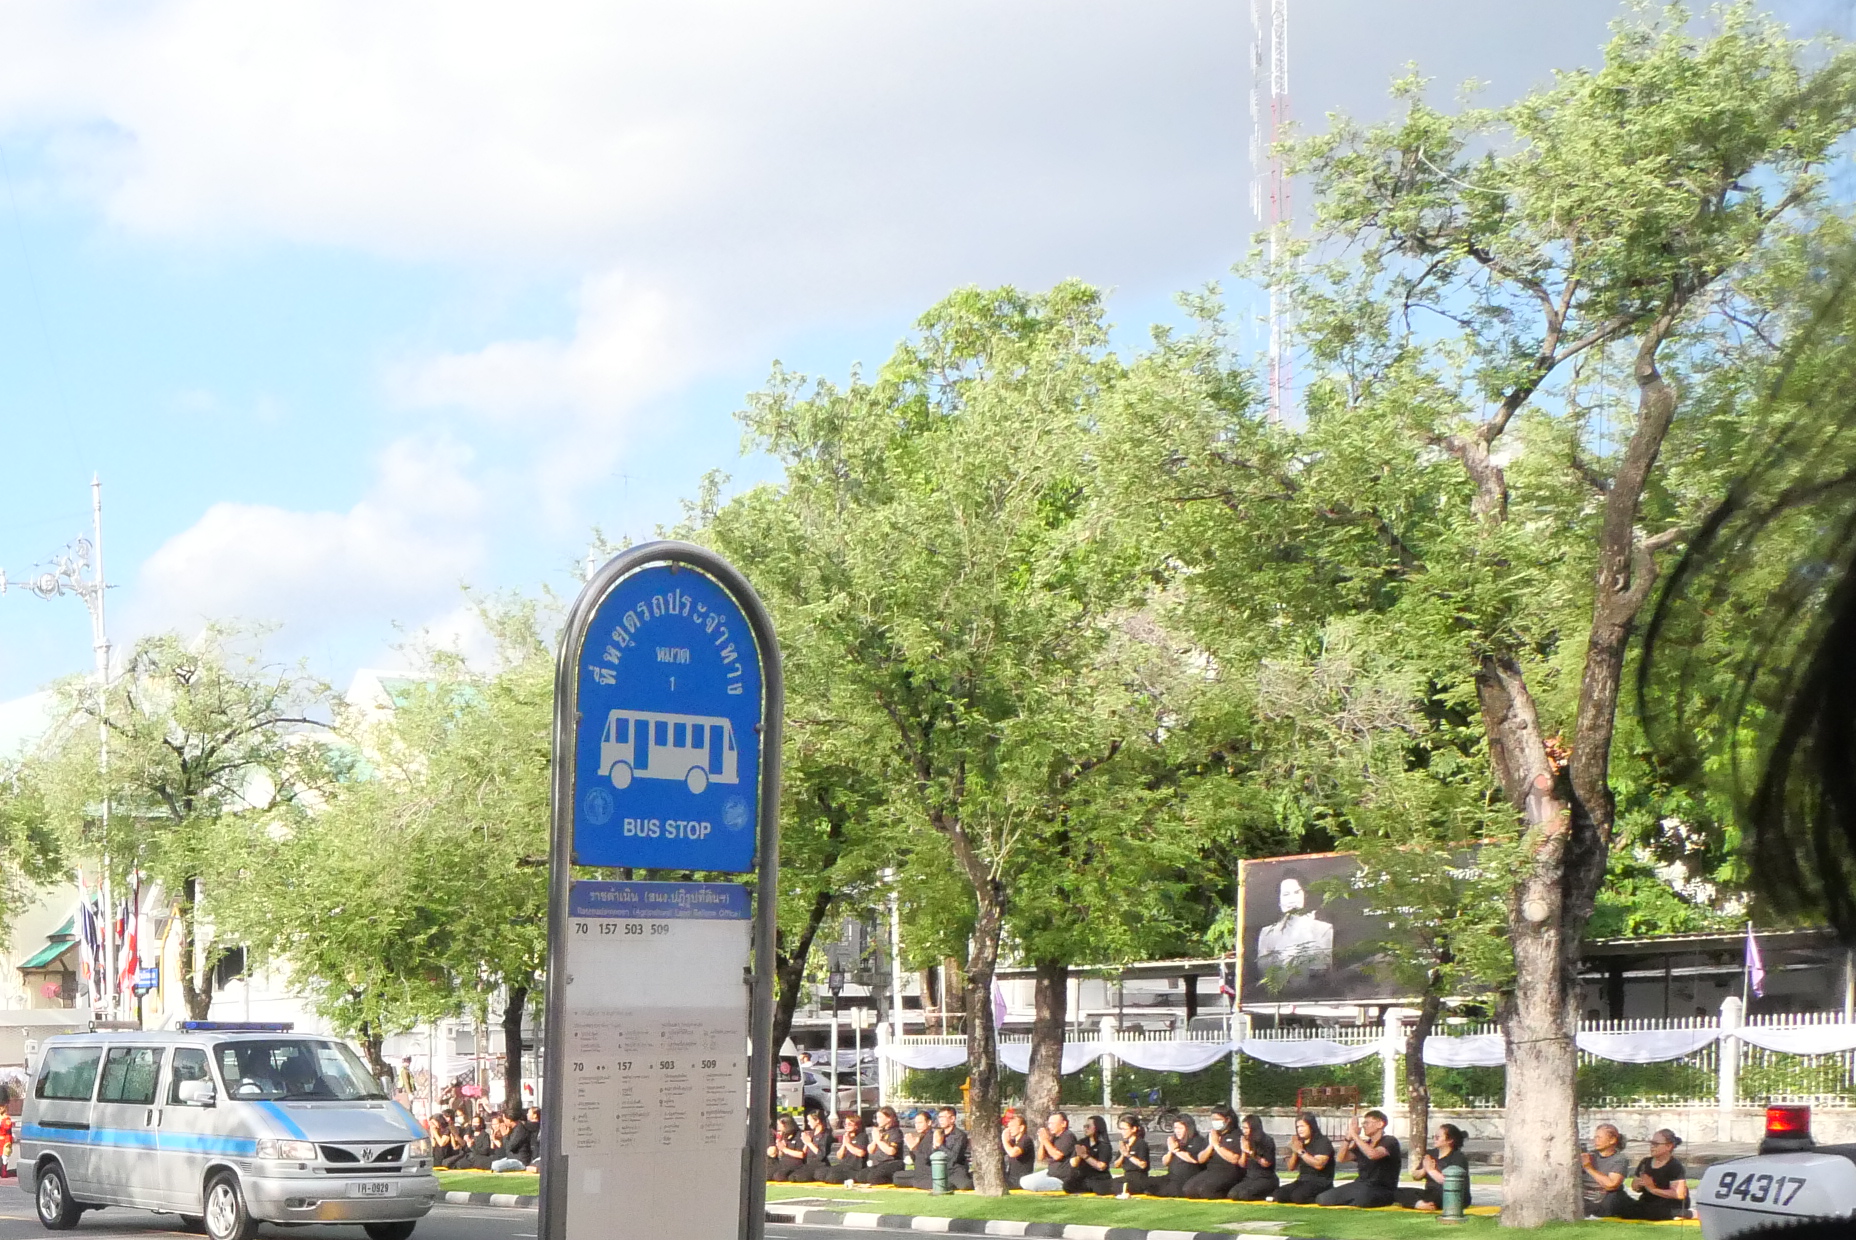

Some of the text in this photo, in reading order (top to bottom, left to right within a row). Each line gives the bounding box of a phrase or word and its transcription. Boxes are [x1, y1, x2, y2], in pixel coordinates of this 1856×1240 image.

[588, 588, 744, 695] ที่หยุดรถประจำทาง
[669, 676, 676, 691] 1
[623, 818, 711, 839] BUS STOP
[575, 923, 670, 935] 70 157 503 509
[573, 1059, 717, 1072] 70 157 503 509
[1715, 1171, 1807, 1206] 94317
